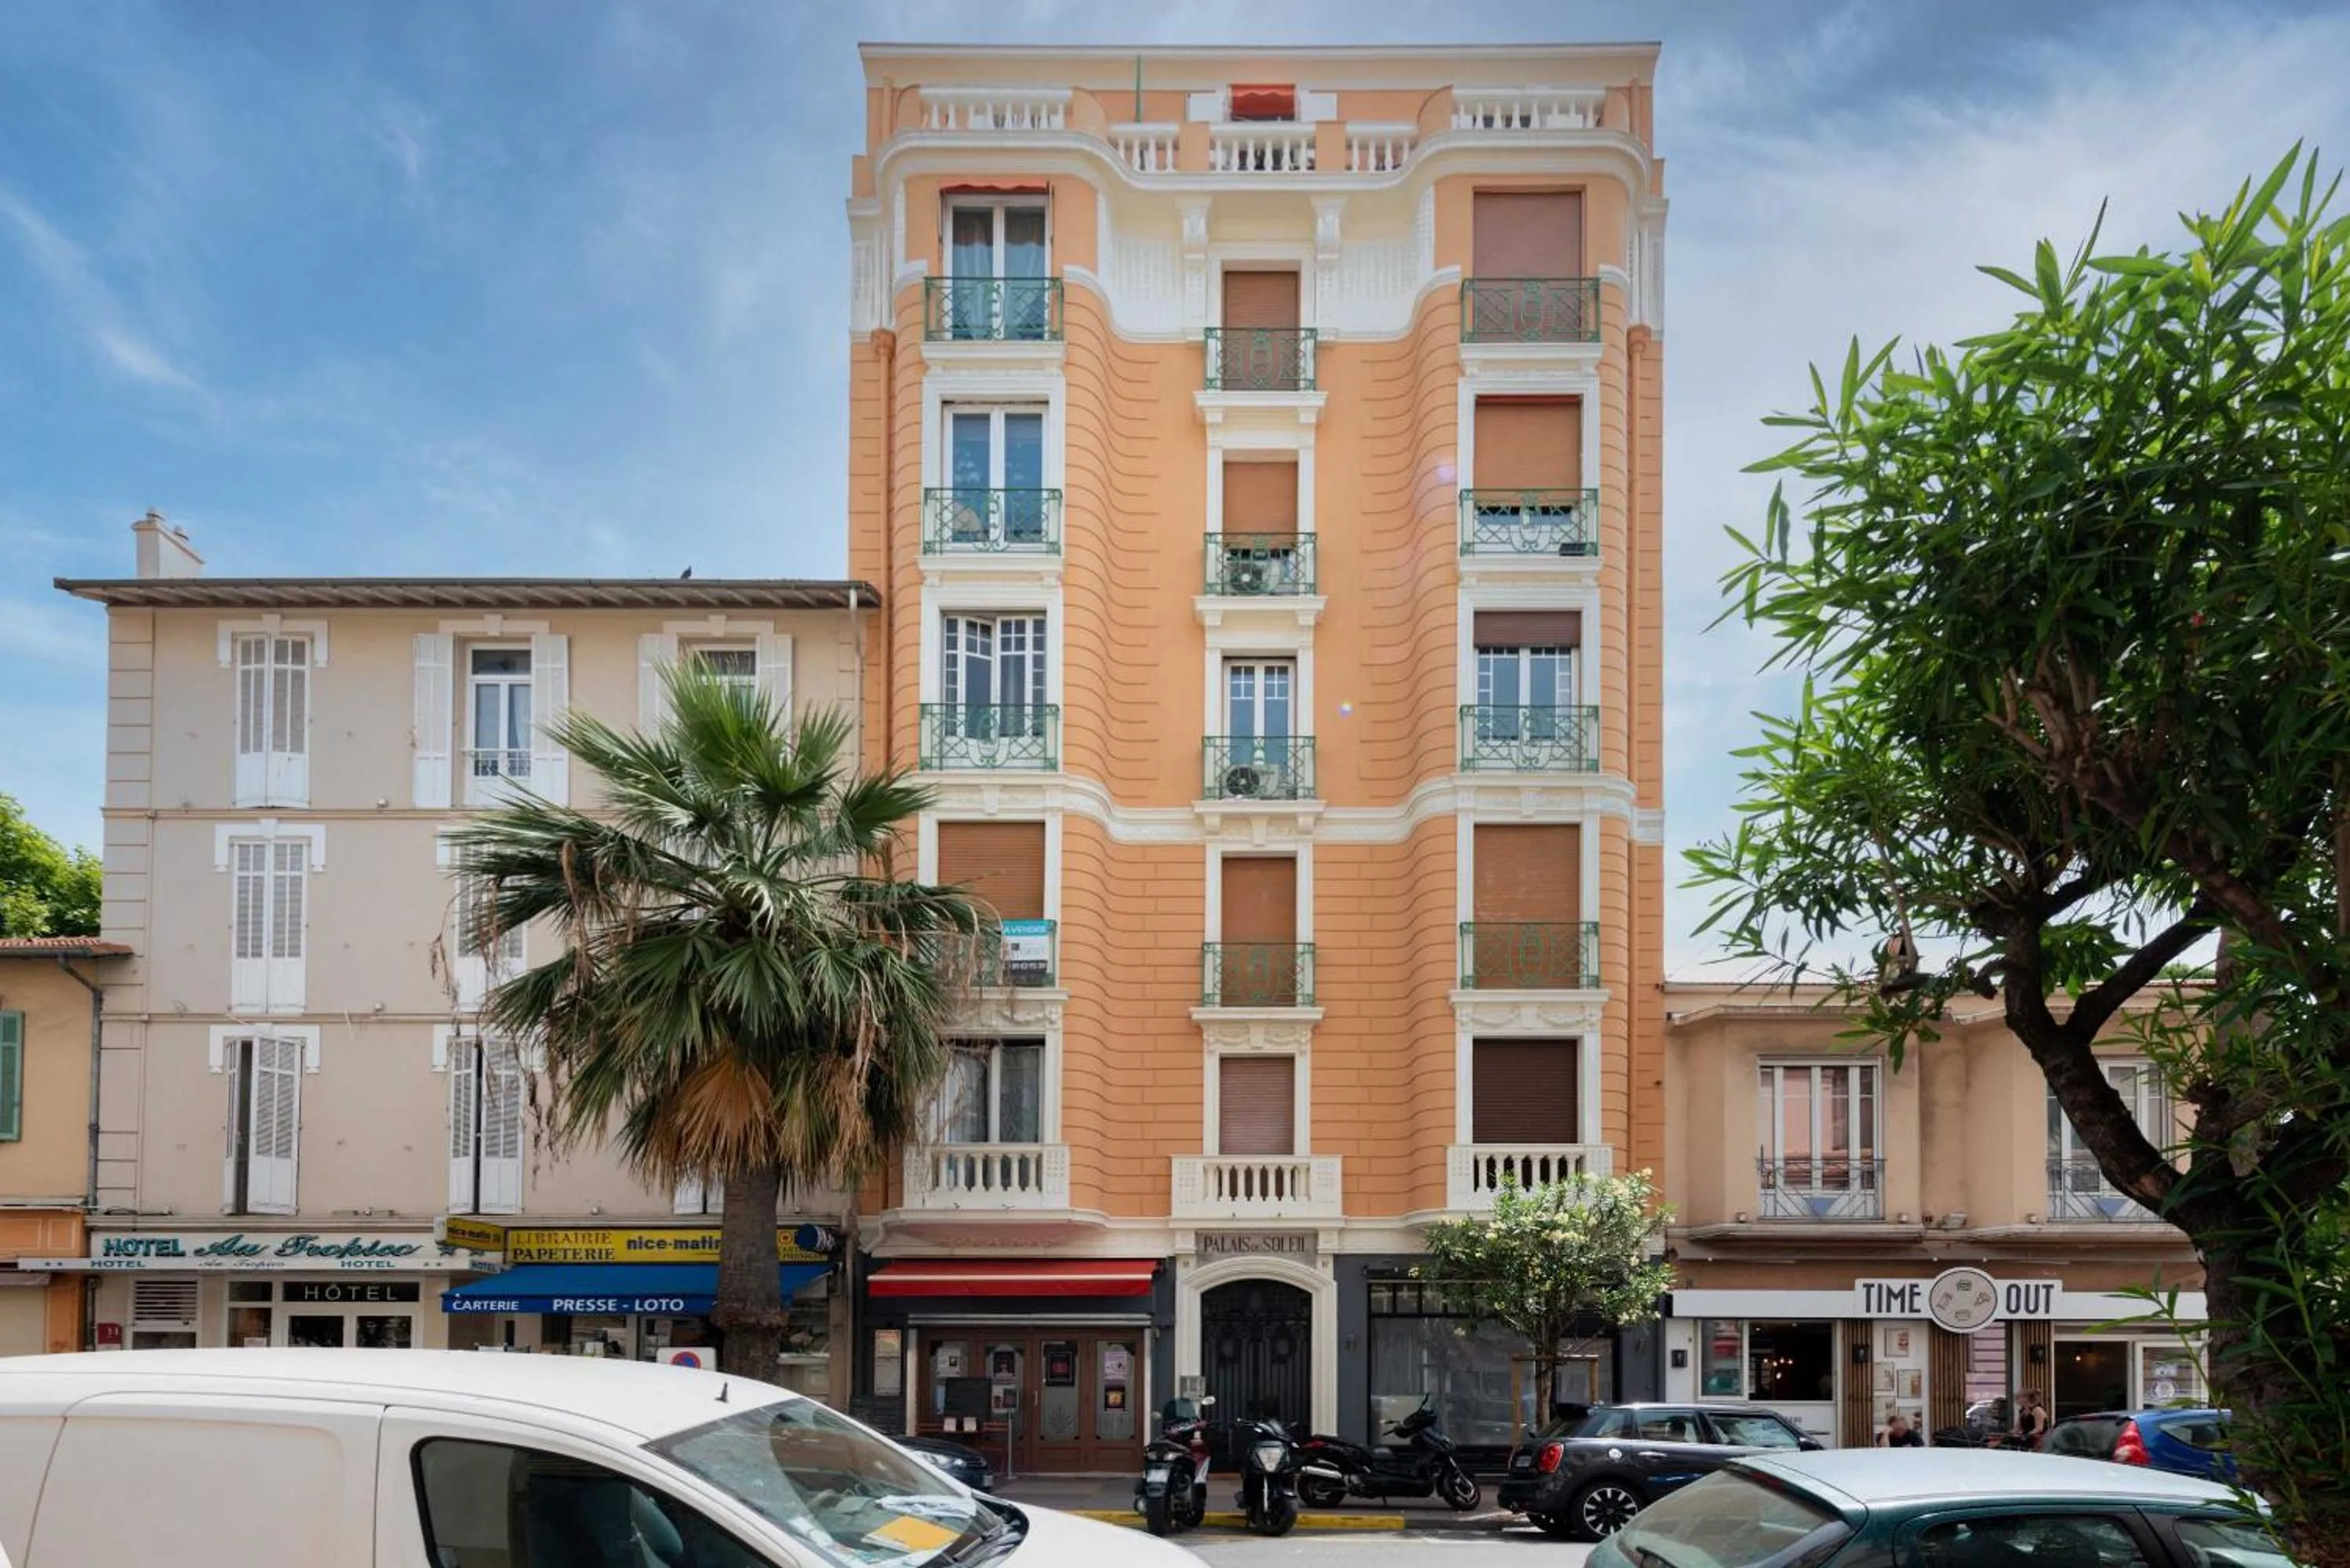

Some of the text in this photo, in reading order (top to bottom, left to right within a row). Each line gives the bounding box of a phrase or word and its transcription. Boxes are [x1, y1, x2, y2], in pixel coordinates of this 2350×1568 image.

[103, 1238, 186, 1257] HOTEL
[194, 1234, 269, 1257] Au
[515, 1231, 613, 1245] LIBRAIRIE
[1203, 1235, 1250, 1253] PALAIS
[1262, 1235, 1305, 1253] SOLEIL
[513, 1248, 616, 1261] PAPETERIE
[90, 1260, 147, 1268] HOTEL
[340, 1260, 396, 1268] HOTEL
[304, 1284, 398, 1301] HÔTEL
[1863, 1282, 2055, 1315] TIME OUT
[452, 1301, 520, 1311] CARTERIE
[552, 1298, 618, 1312] PRESSE
[635, 1299, 685, 1312] LOTO
